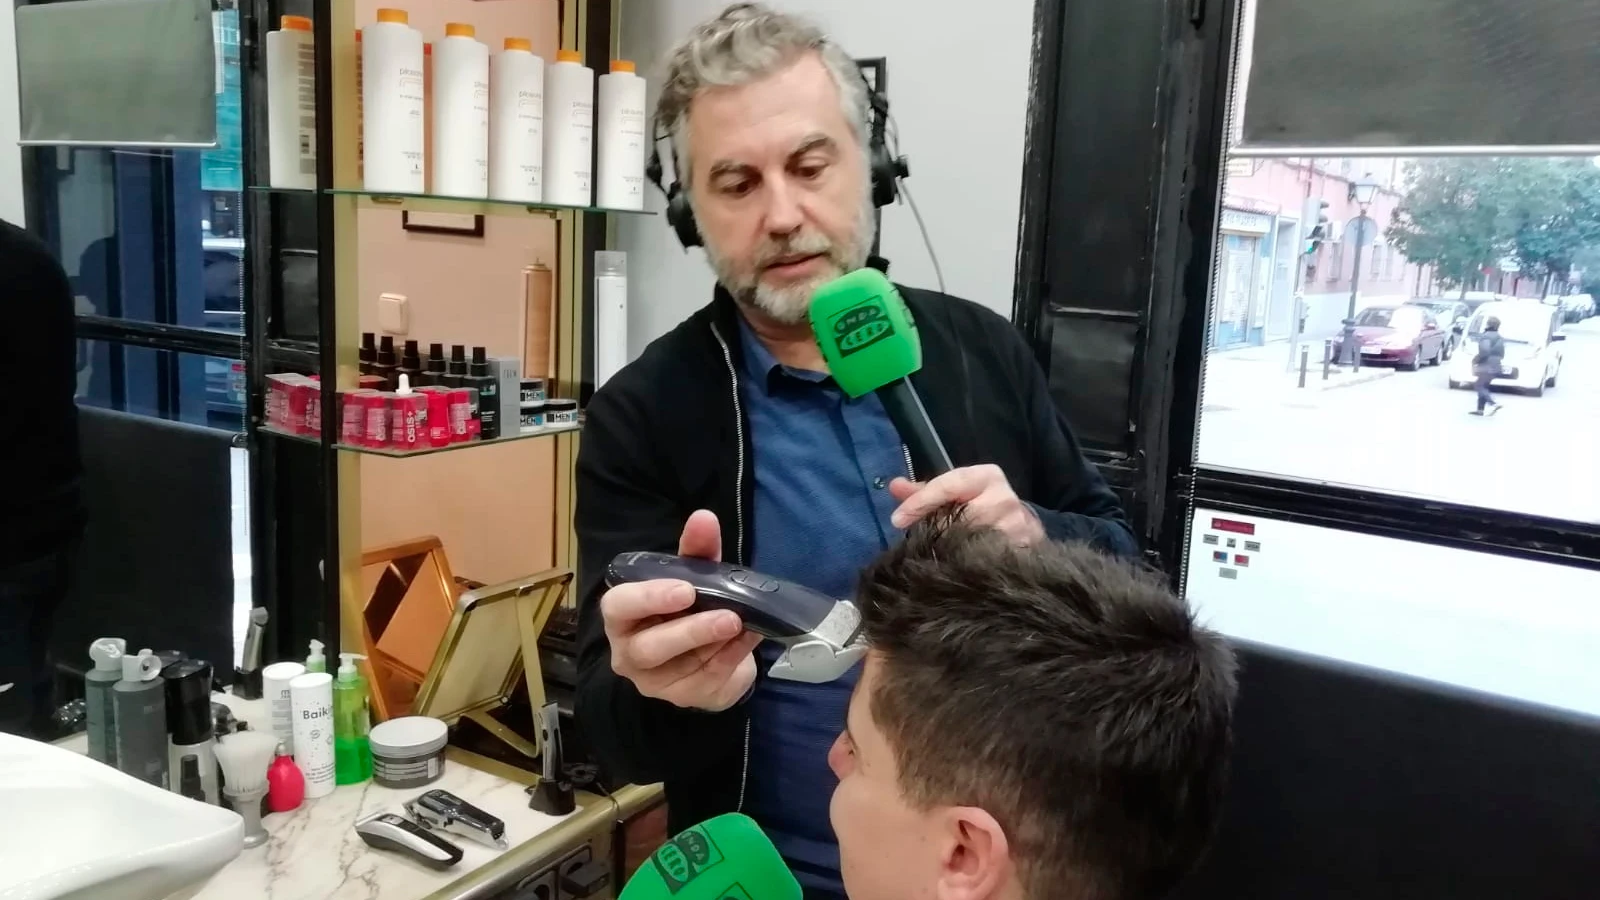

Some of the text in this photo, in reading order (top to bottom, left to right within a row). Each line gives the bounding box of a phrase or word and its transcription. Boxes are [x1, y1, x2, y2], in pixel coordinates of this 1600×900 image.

[837, 308, 877, 330] ONDA
[846, 322, 882, 345] CERO
[406, 410, 416, 443] OSIS+
[555, 412, 570, 420] MEN
